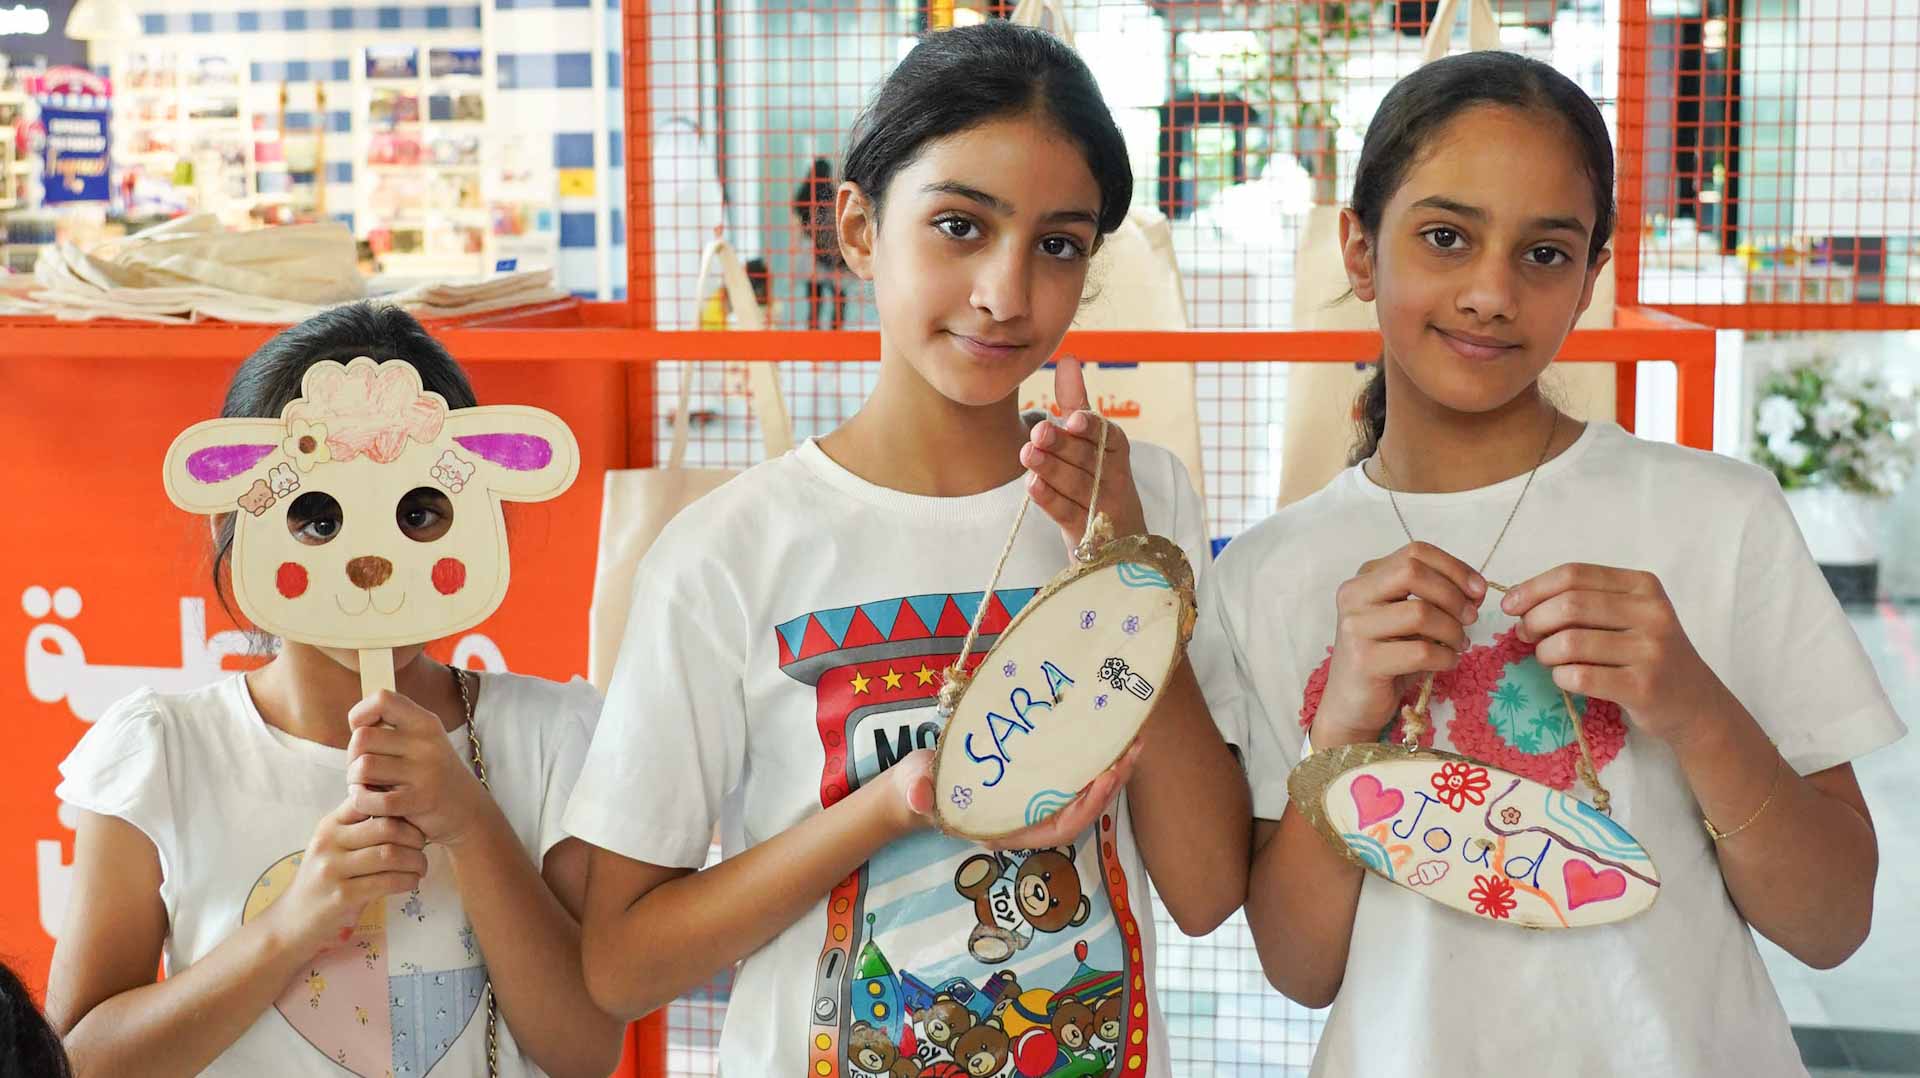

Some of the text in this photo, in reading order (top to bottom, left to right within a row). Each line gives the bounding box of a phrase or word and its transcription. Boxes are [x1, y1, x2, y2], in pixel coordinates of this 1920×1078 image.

[964, 661, 1075, 787] SARA
[1392, 791, 1552, 889] Joud
[993, 885, 1016, 924] TOY
